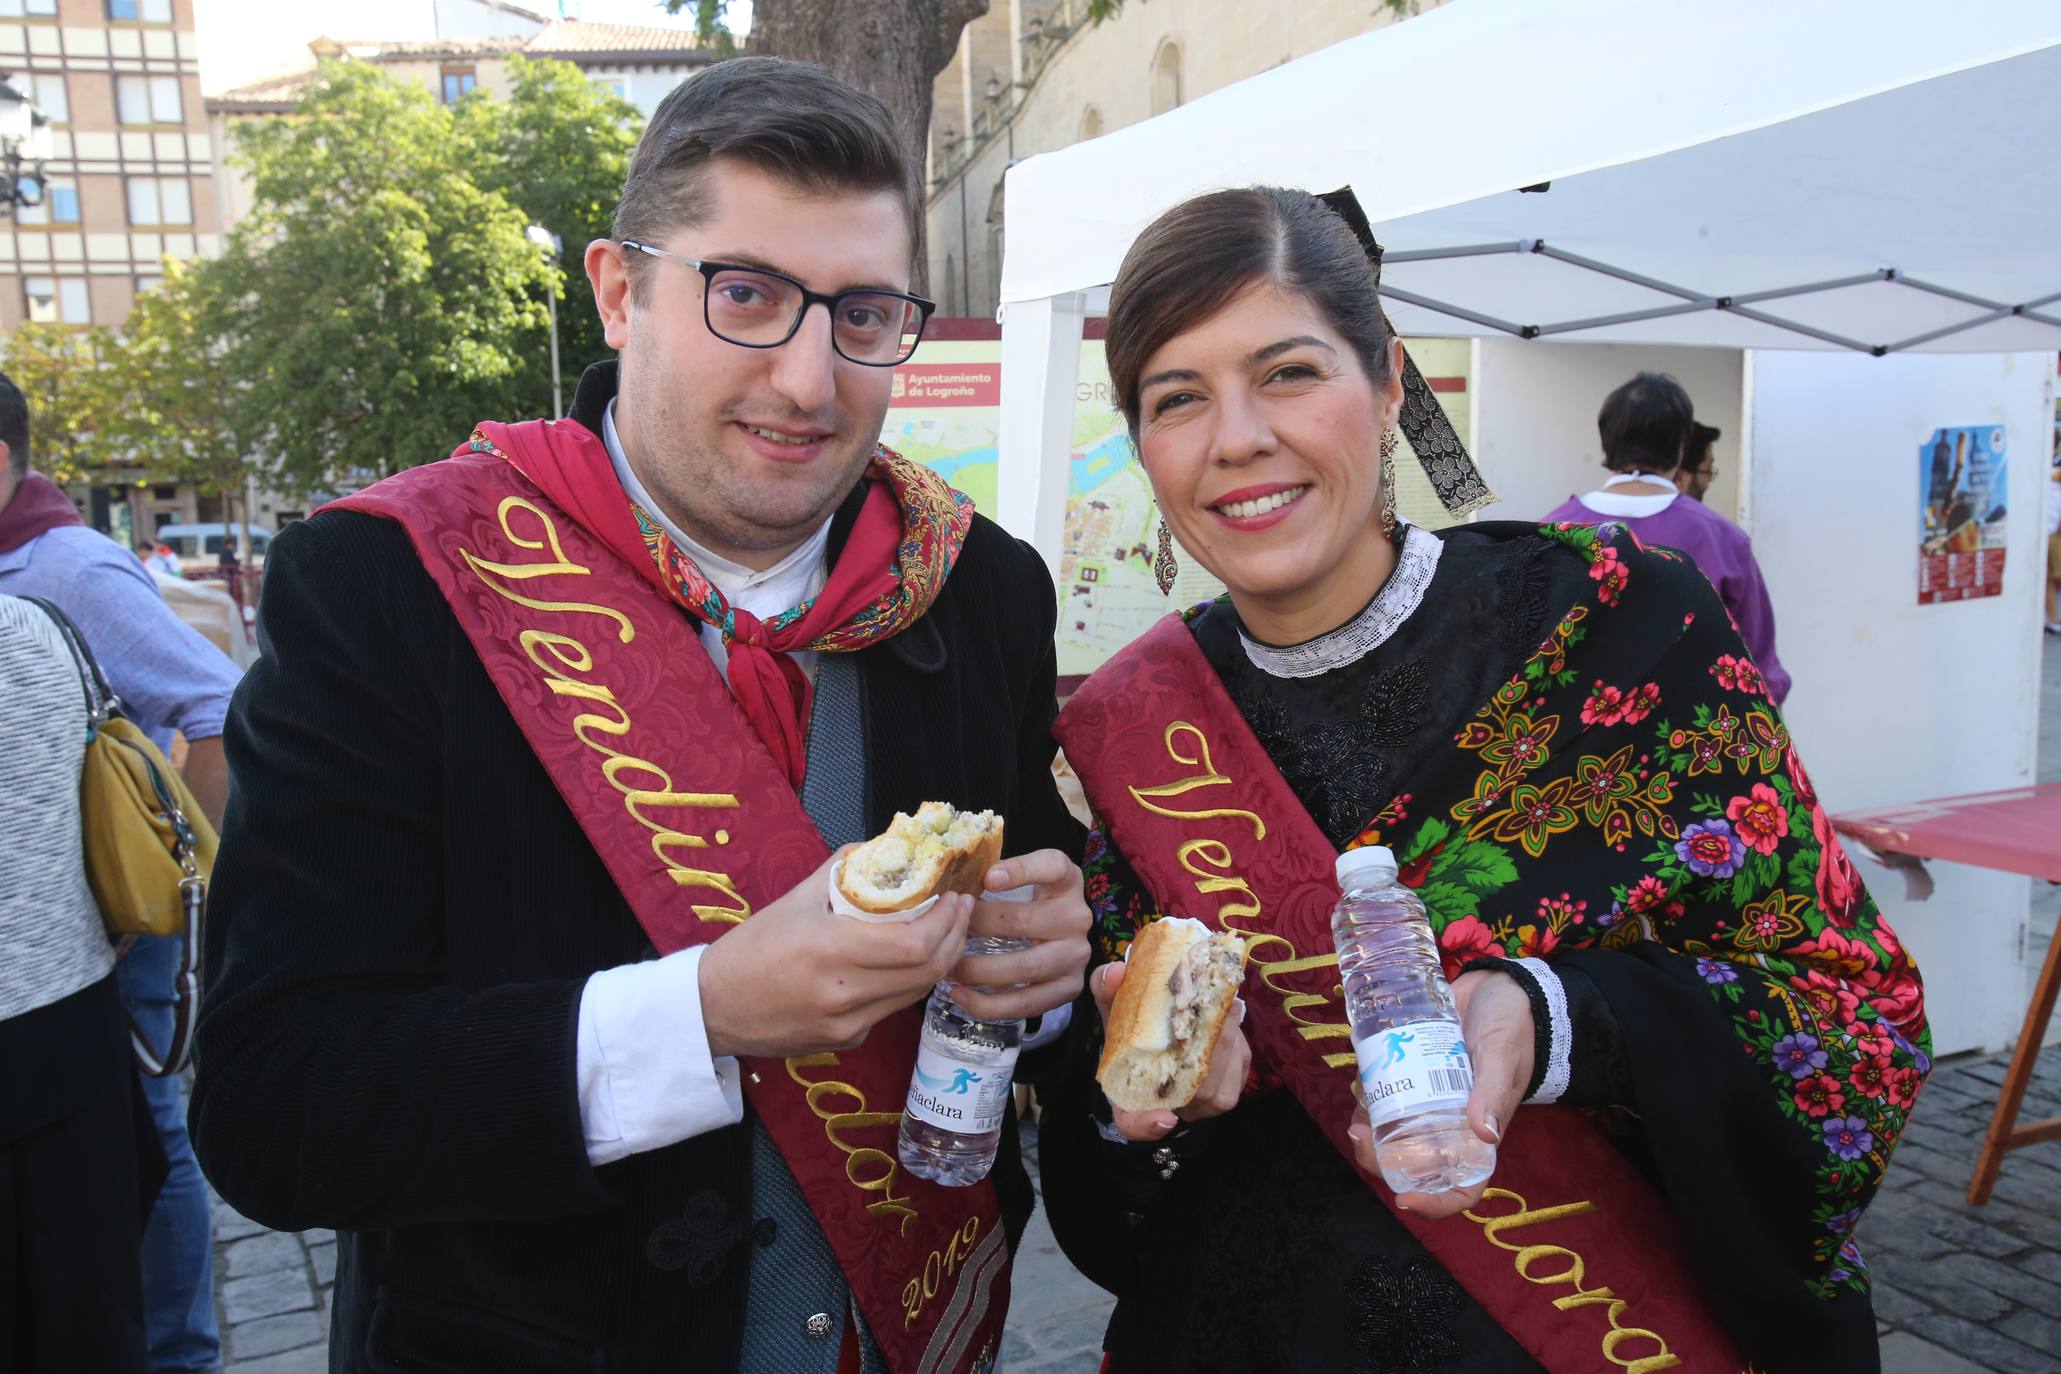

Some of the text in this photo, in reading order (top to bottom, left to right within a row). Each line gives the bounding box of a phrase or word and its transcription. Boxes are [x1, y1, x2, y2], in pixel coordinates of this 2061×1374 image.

[908, 373, 991, 386] Ayuntamiento
[908, 386, 975, 398] de Logroño
[902, 1216, 979, 1330] 2019
